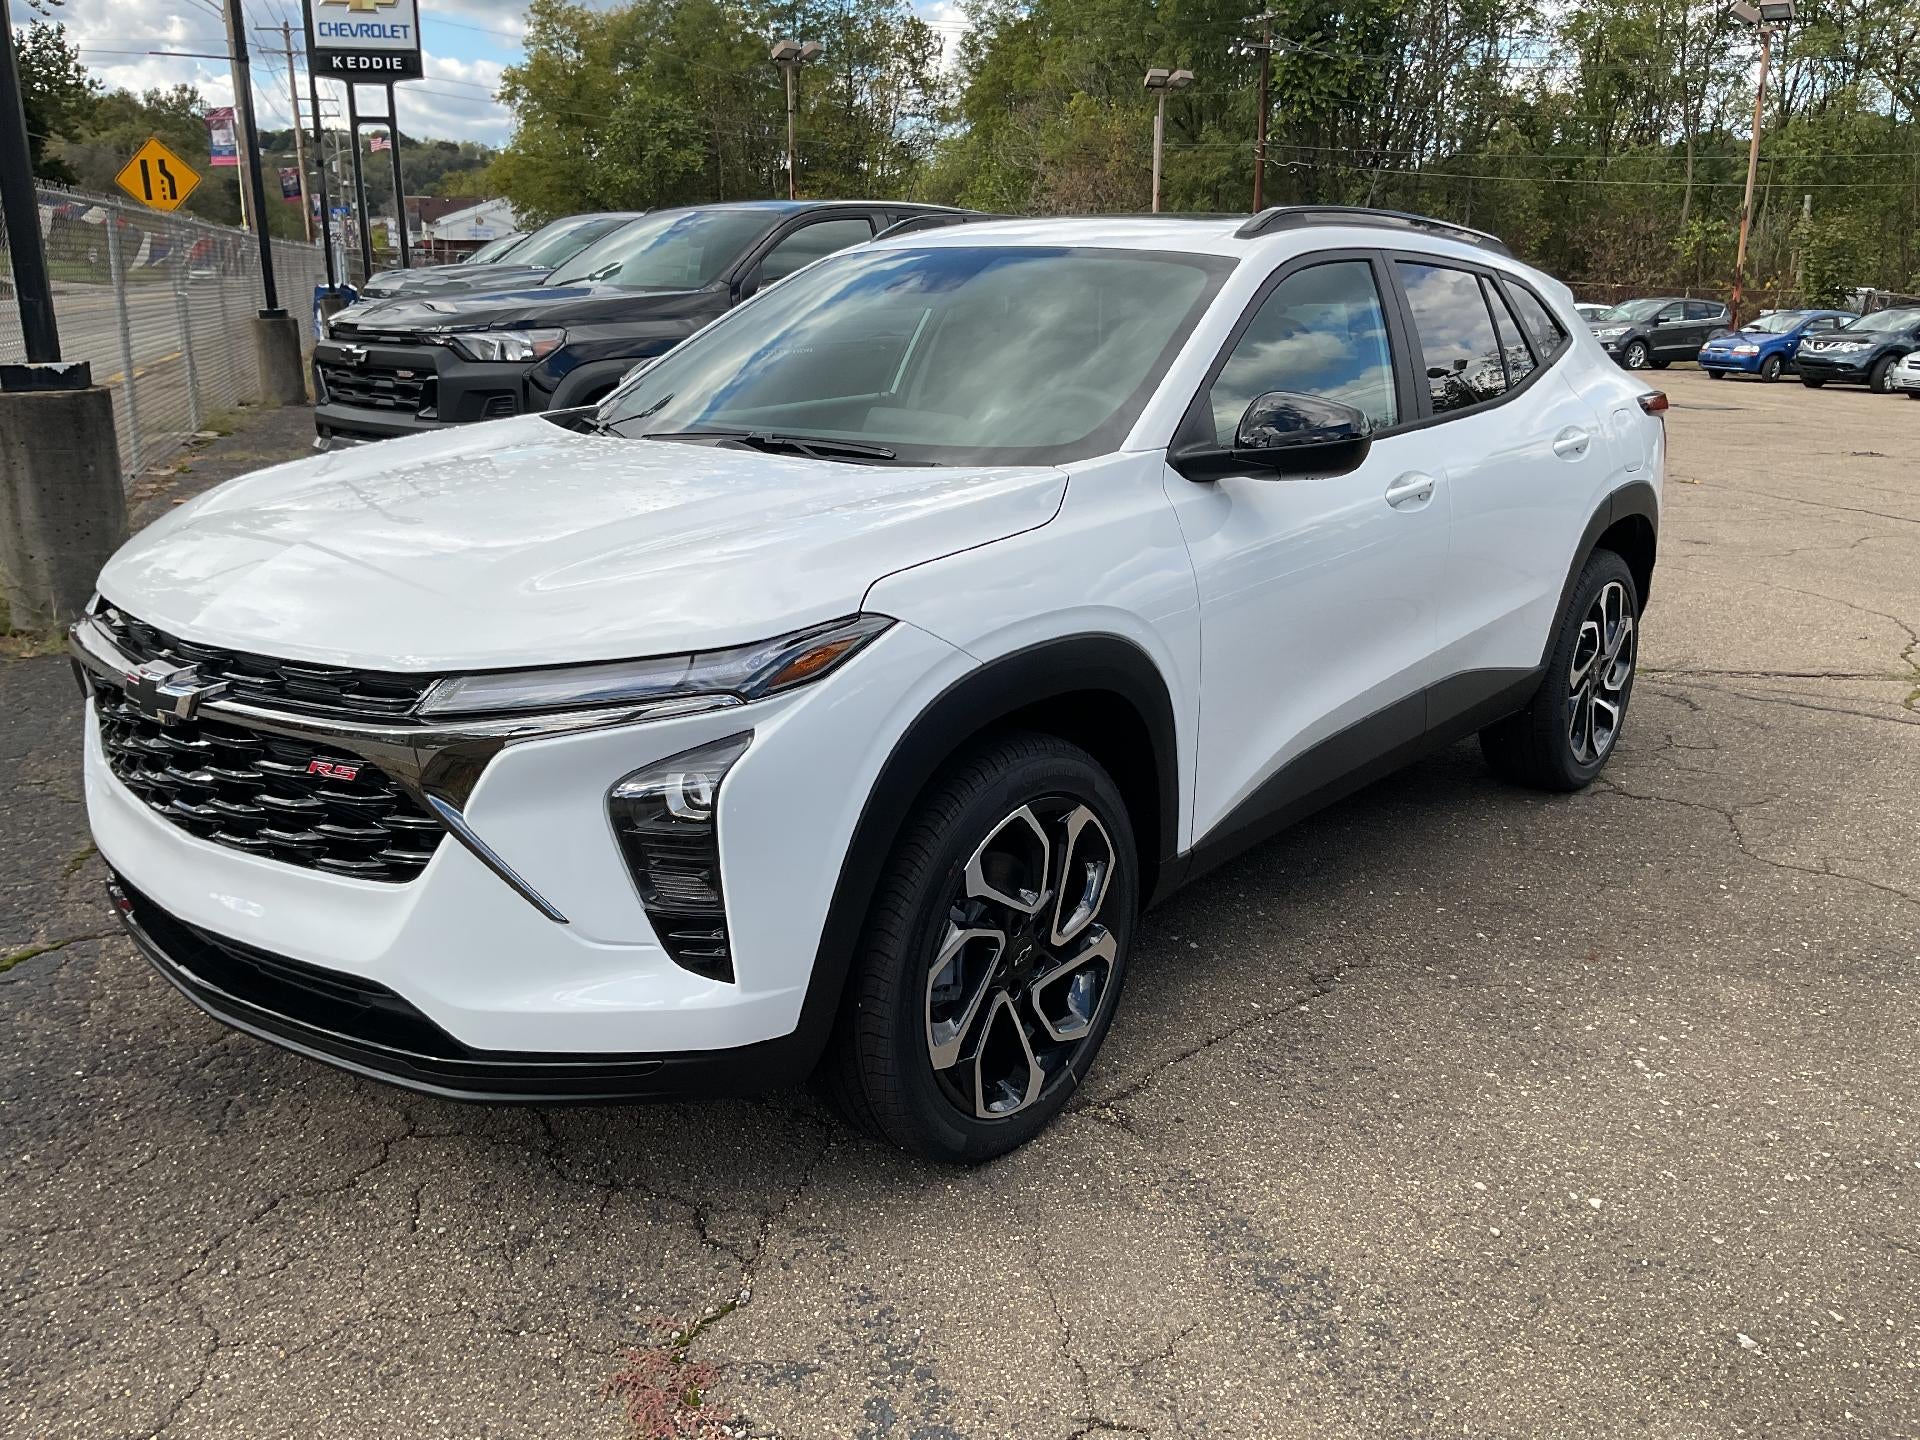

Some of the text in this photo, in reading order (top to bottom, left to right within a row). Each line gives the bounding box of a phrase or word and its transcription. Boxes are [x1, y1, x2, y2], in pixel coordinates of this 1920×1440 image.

[318, 22, 411, 39] CHEVROLET
[332, 56, 403, 70] KEDDIE
[306, 760, 360, 781] RS
